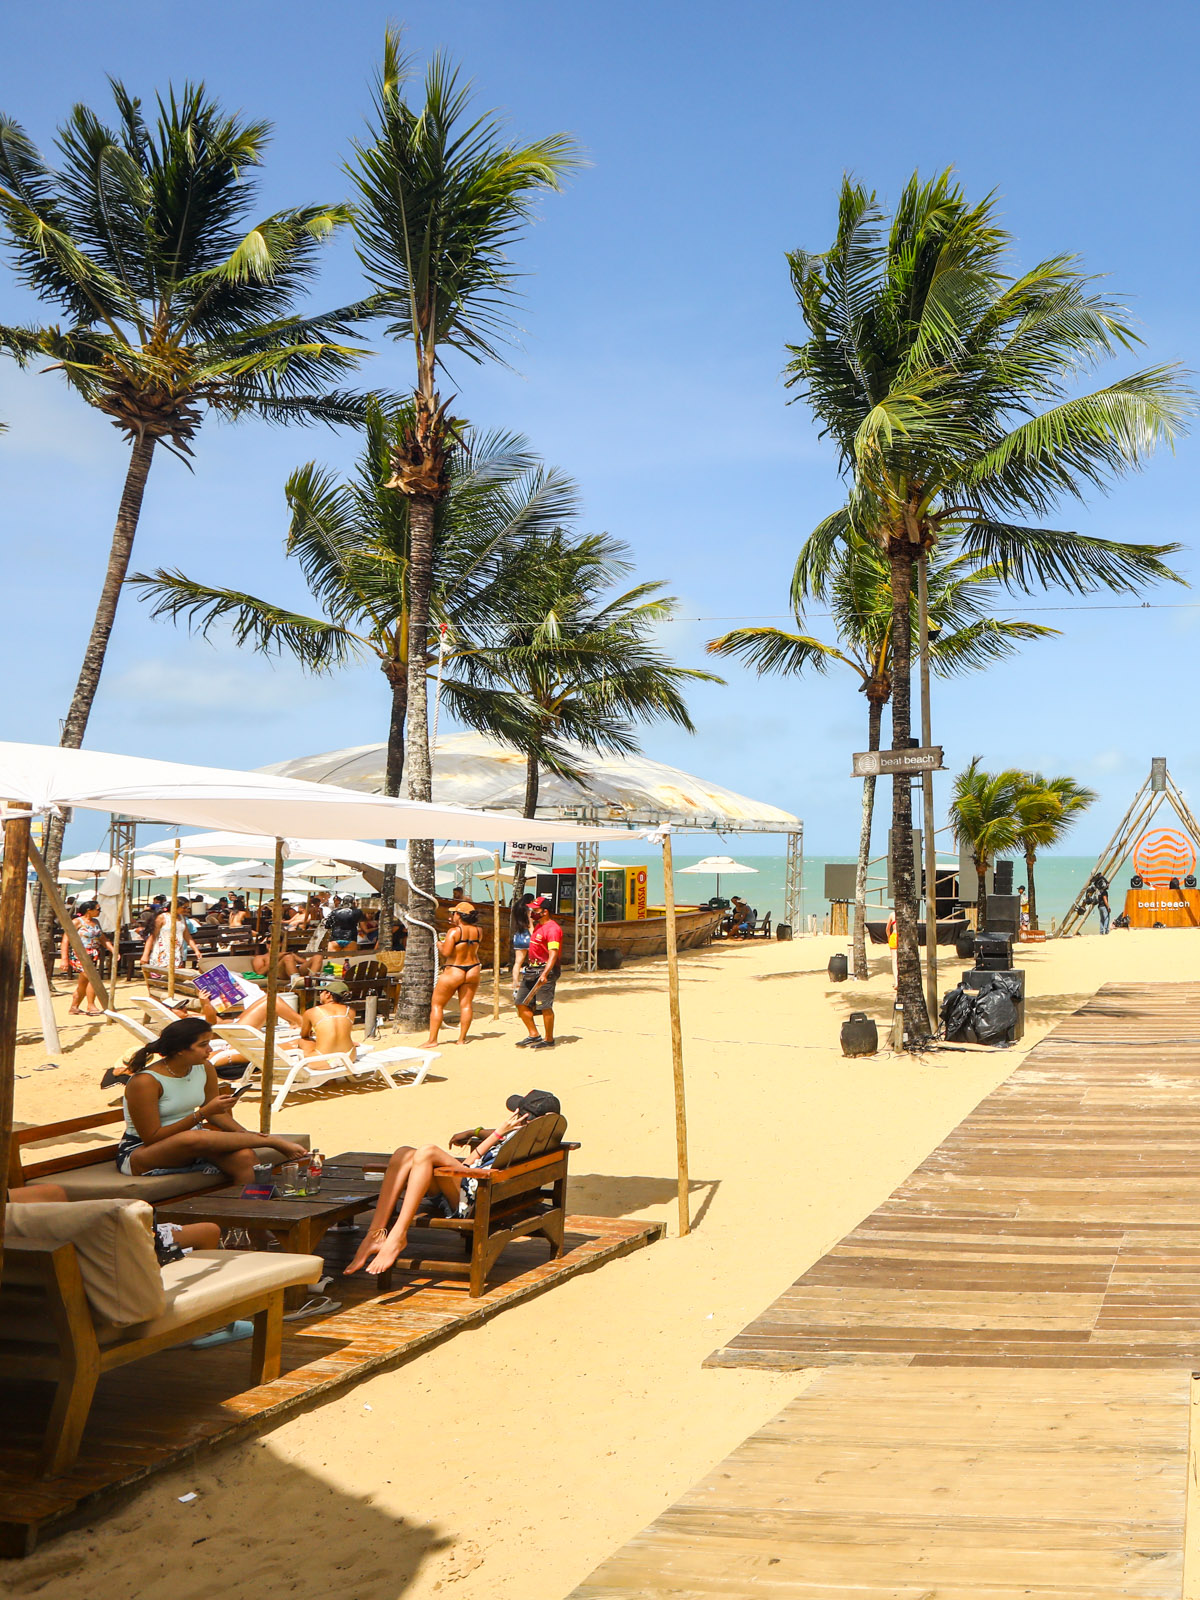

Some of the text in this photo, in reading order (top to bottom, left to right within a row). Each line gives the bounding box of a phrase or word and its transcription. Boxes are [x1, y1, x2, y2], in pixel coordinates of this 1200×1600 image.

[881, 754, 935, 766] beat beach
[512, 841, 547, 852] Bar Praia
[637, 886, 645, 920] DEVASSA
